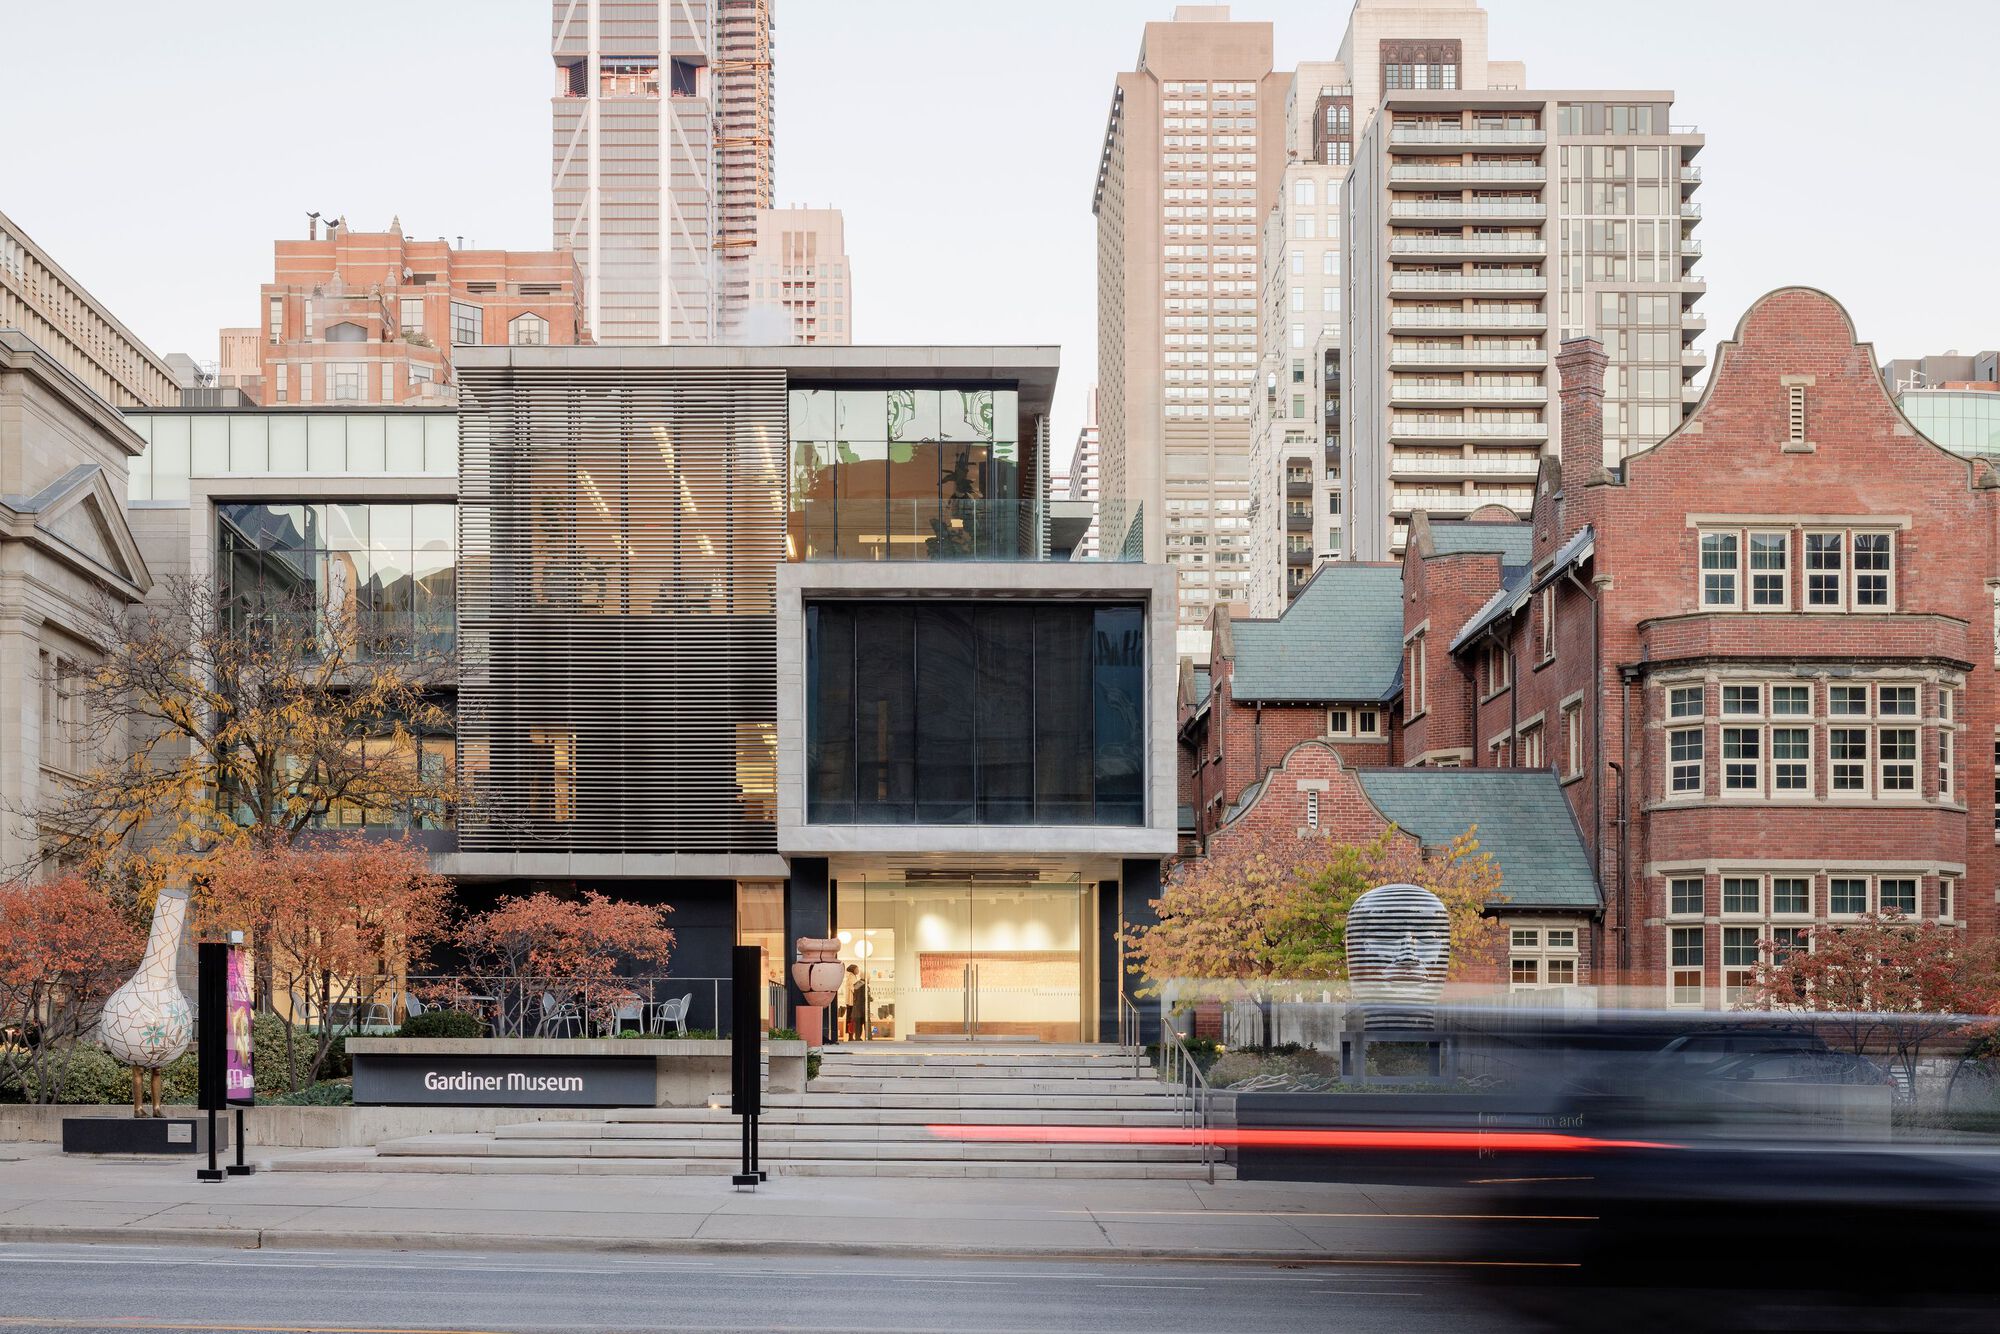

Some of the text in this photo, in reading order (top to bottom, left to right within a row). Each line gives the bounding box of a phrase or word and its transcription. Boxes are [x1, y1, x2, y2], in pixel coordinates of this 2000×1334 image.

[424, 1071, 583, 1091] Gardiner Museum
[1559, 1112, 1584, 1127] and
